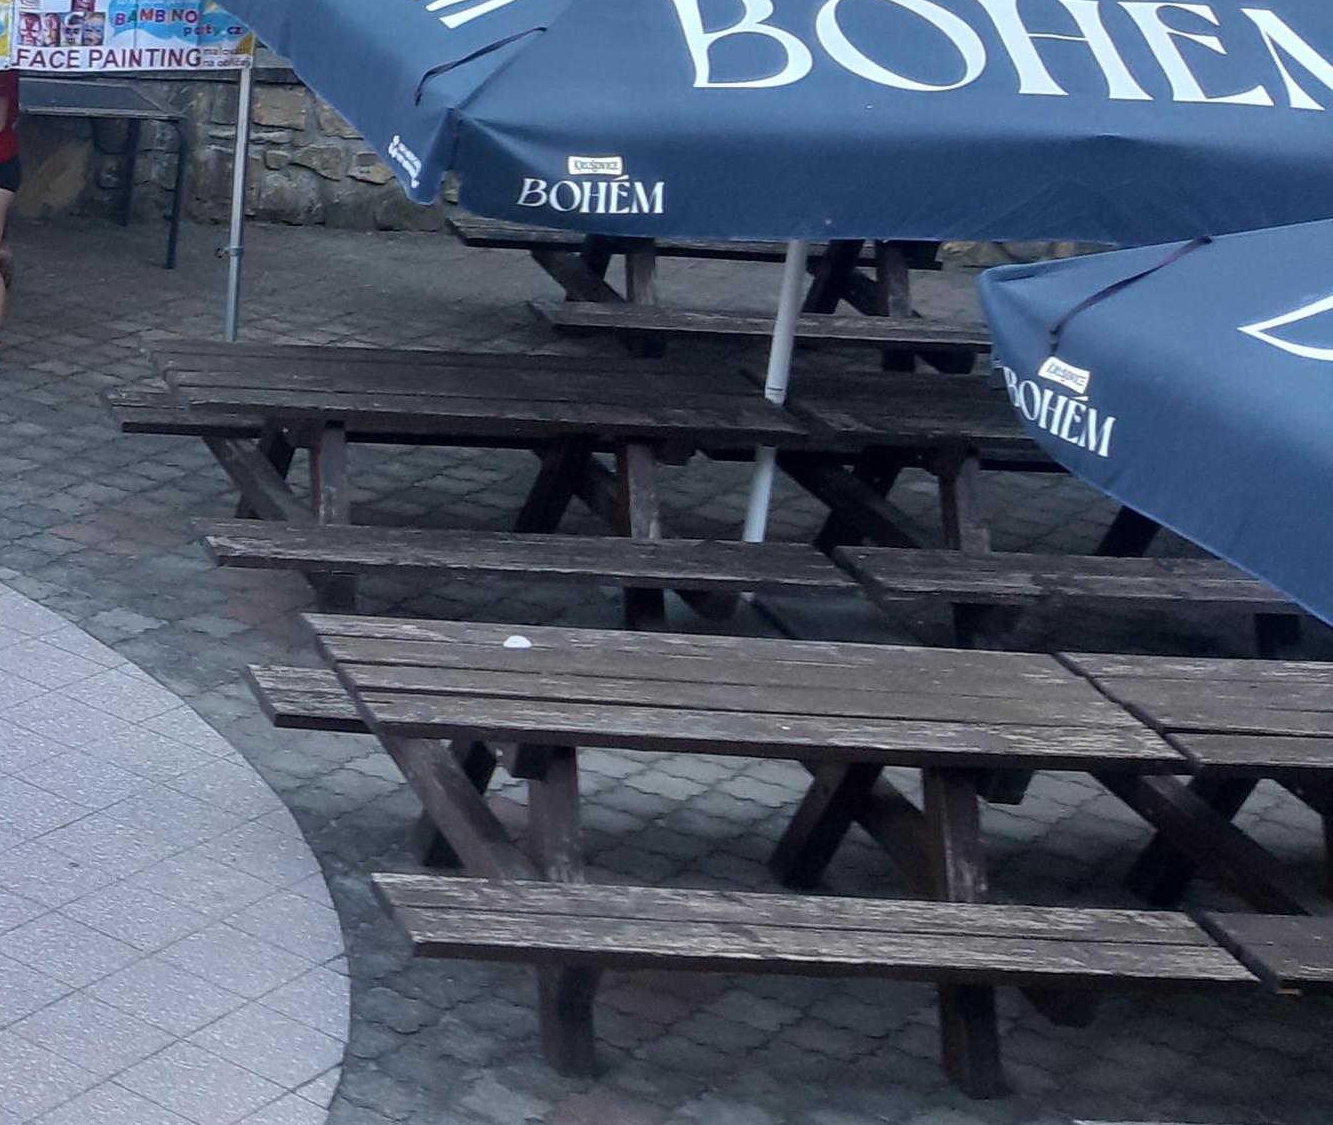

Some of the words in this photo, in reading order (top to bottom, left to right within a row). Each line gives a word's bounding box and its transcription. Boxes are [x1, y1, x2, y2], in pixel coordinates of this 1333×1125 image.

[114, 8, 199, 26] BAMBINO
[15, 48, 80, 69] FACE
[89, 48, 201, 69] PAINTING
[516, 174, 666, 215] BOHÉM
[1002, 366, 1117, 458] BOHÉM
